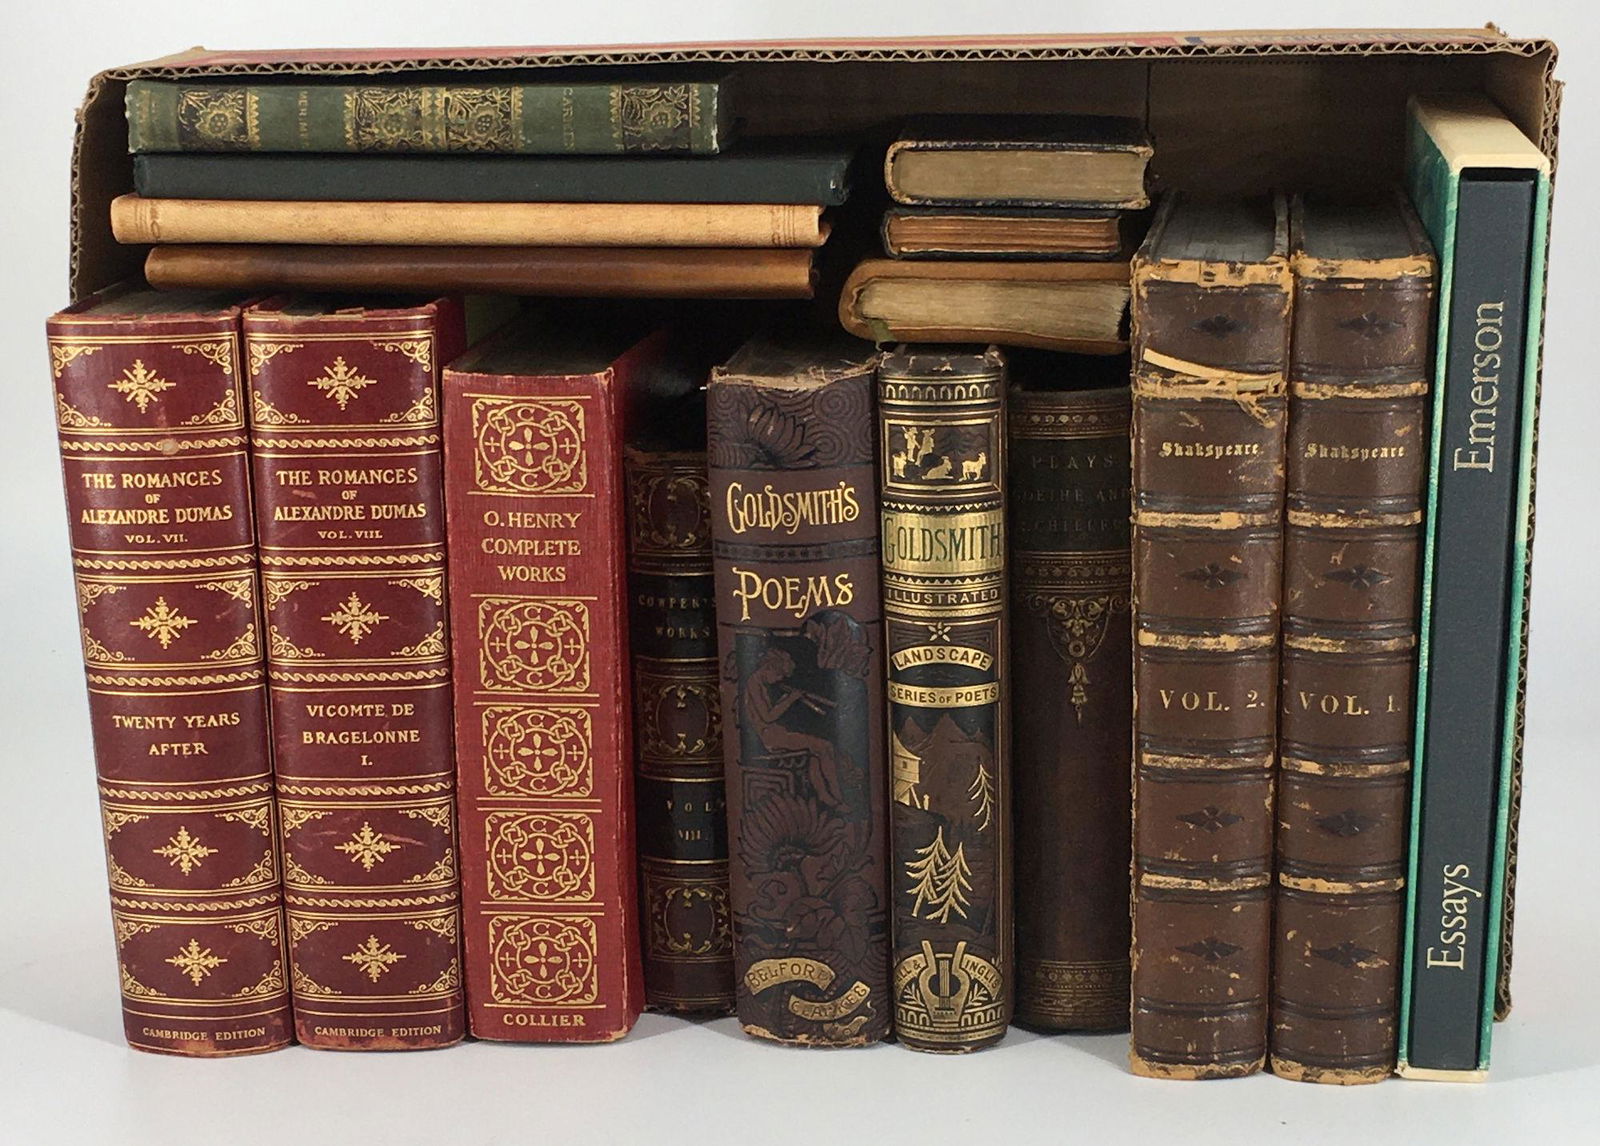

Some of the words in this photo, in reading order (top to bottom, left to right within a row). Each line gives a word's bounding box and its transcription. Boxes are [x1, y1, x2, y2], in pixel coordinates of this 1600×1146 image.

[1453, 301, 1504, 473] Emerson
[82, 471, 116, 489] THE
[122, 469, 223, 489] ROMANCES
[275, 470, 313, 486] THE
[318, 468, 419, 485] ROMANCES
[145, 492, 161, 504] OF
[342, 490, 358, 501] OF
[81, 508, 170, 525] ALEXANDRE
[175, 506, 233, 522] DUMAS
[274, 505, 367, 521] ALEXANDRE
[370, 503, 427, 519] DUMAS
[726, 481, 860, 535] GOLDSMITH'S
[508, 511, 582, 529] HENRY
[125, 534, 161, 544] VOL.
[163, 533, 188, 544] VII.
[318, 531, 353, 540] VOL.
[884, 517, 1002, 564] GOLDSMITH
[481, 537, 582, 556] COMPLETE
[497, 565, 567, 583] WORKS
[732, 567, 854, 622] POEMS
[887, 588, 998, 604] ILLUSTRATED
[894, 647, 991, 669] LANDSCAPE
[890, 685, 936, 704] SERIES
[939, 696, 952, 704] OF
[955, 686, 997, 703] POETS
[1159, 689, 1231, 712] VOL.
[1246, 689, 1266, 709] 2.
[1299, 691, 1370, 716] VOL.
[306, 703, 385, 718] VICOMTE
[391, 702, 415, 717] DE
[112, 715, 176, 729] TWENTY
[183, 711, 240, 727] YEARS
[302, 729, 420, 744] BRAGELONNE
[148, 742, 208, 757] AFTER
[360, 754, 373, 766] I.
[1426, 864, 1482, 971] Essays
[503, 1011, 587, 1027] COLLIER
[143, 1026, 208, 1041] CAMBRIDGE
[215, 1026, 266, 1041] EDITION
[314, 1025, 385, 1038] CAMBRIDGE
[391, 1025, 442, 1037] EDITION
